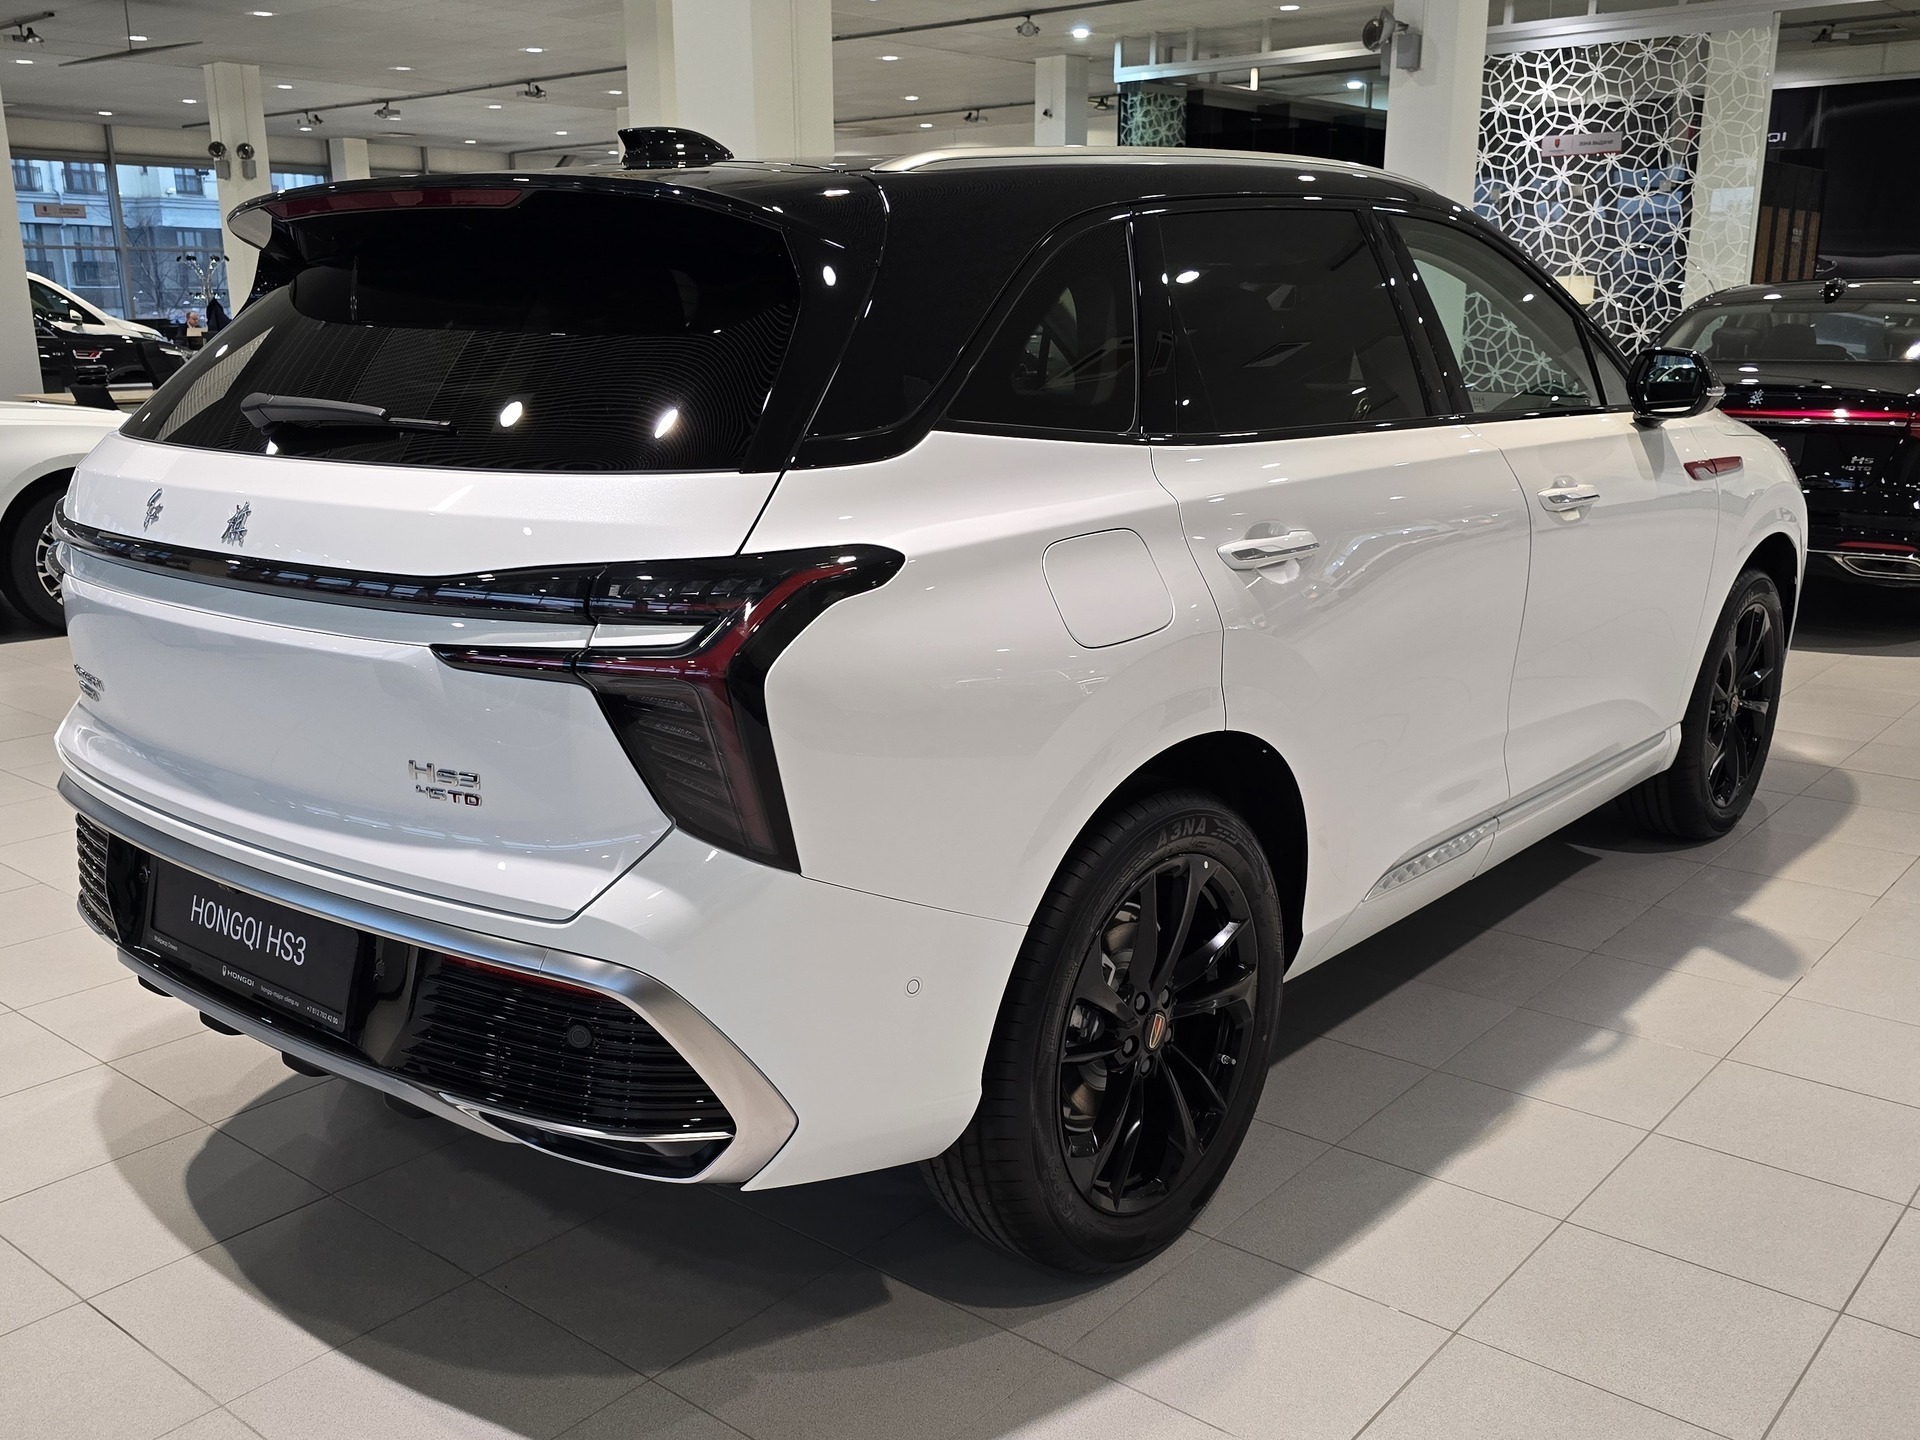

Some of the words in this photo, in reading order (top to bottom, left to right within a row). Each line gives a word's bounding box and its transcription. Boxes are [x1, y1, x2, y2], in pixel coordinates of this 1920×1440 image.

[408, 760, 481, 790] HS3
[415, 784, 482, 807] 45TD
[190, 894, 263, 950] HONGQI
[266, 925, 307, 966] HS3
[227, 969, 255, 987] HONGQI
